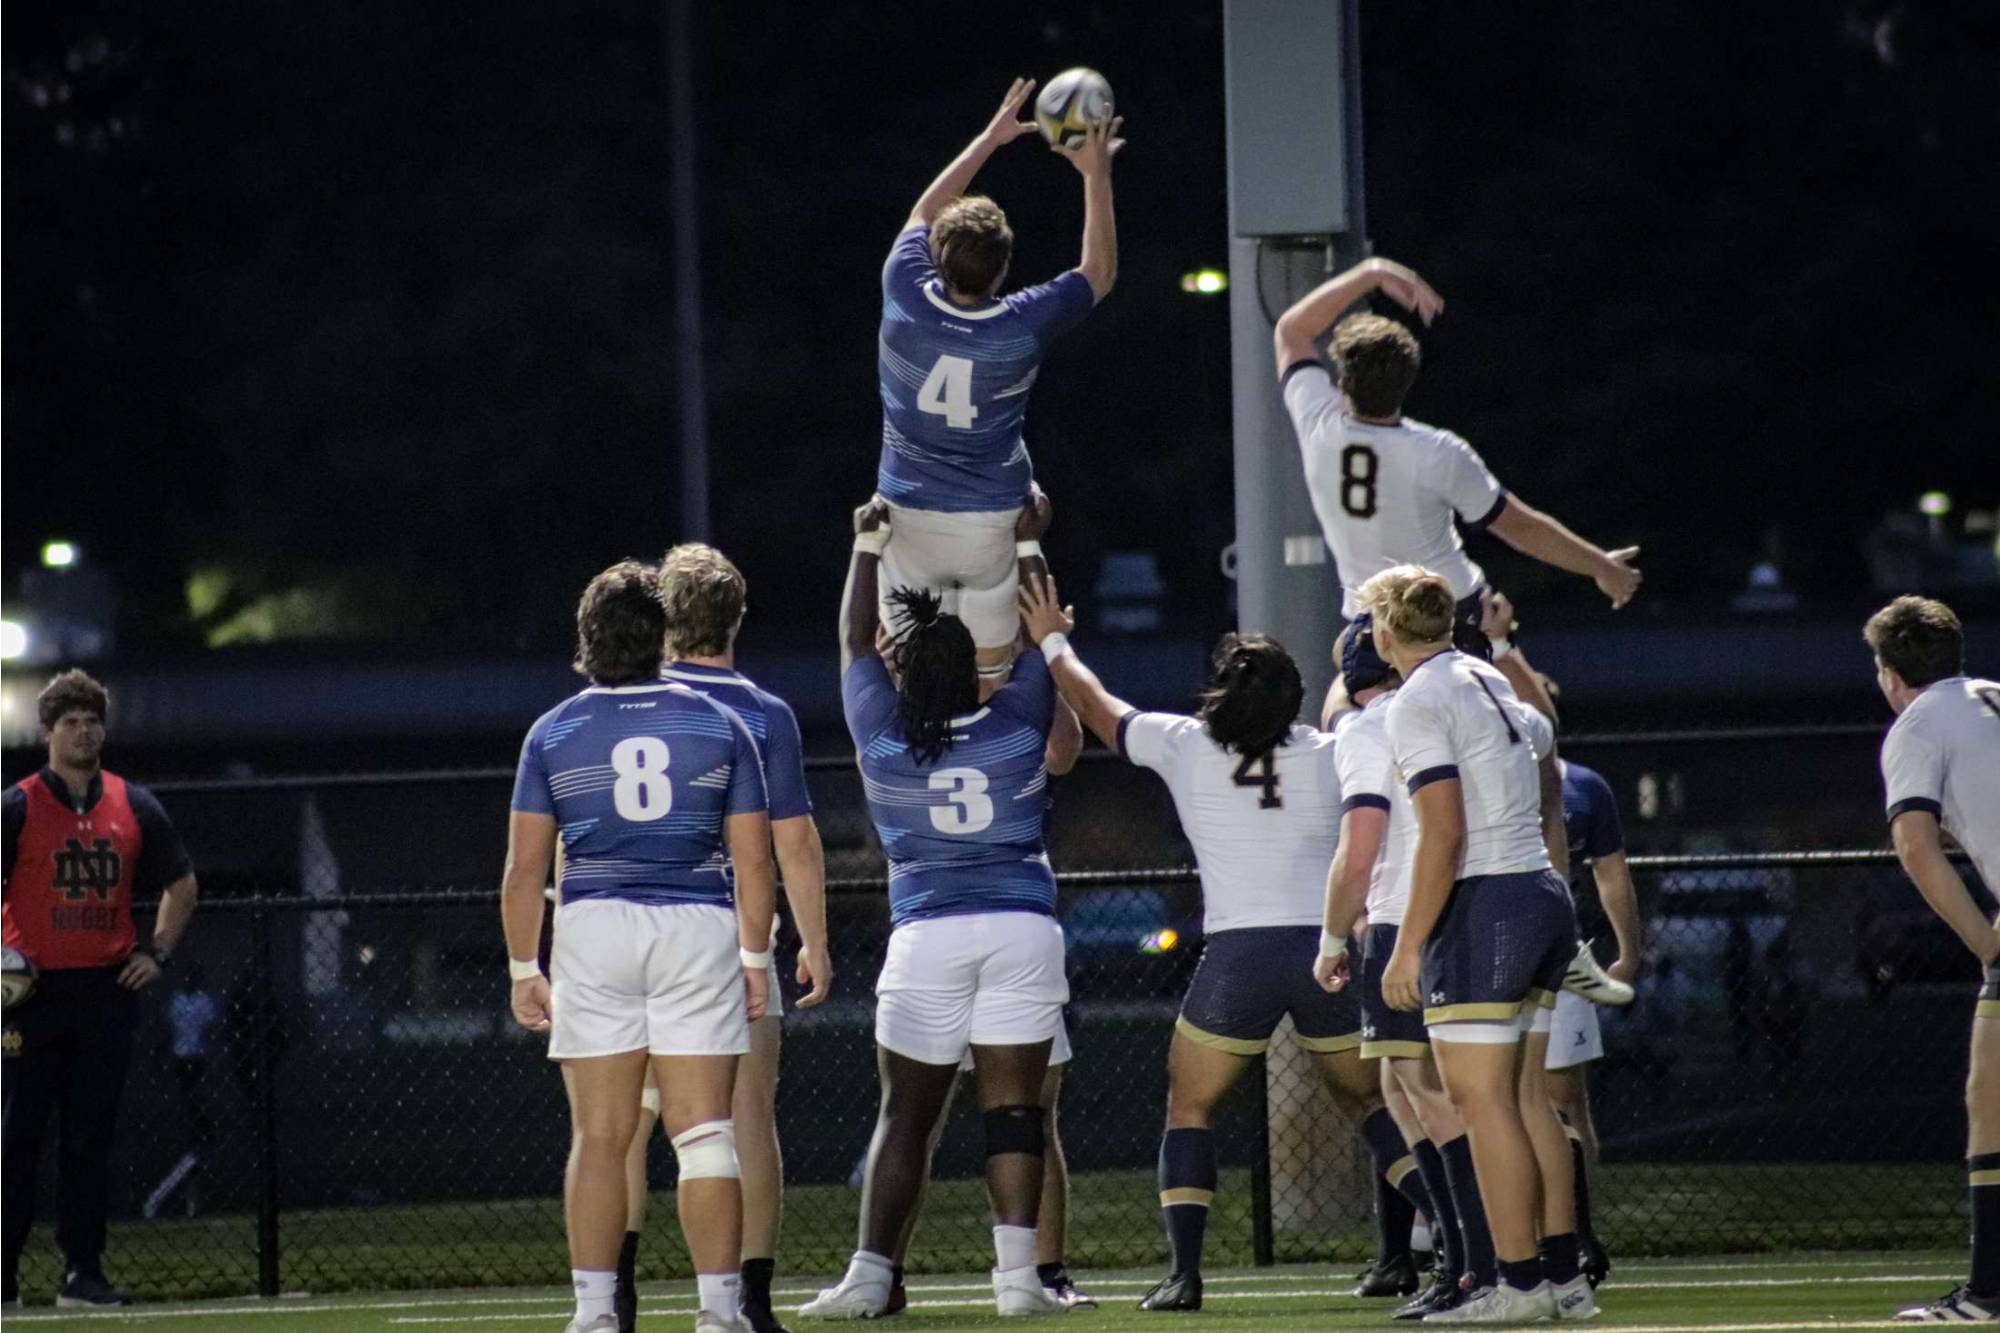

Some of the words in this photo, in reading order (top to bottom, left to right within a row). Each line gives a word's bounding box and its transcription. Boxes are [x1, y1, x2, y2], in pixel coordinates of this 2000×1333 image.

[917, 354, 978, 429] 4
[1341, 443, 1378, 519] 8
[611, 736, 673, 822] 8
[928, 767, 994, 834] 3
[1232, 750, 1282, 809] 4
